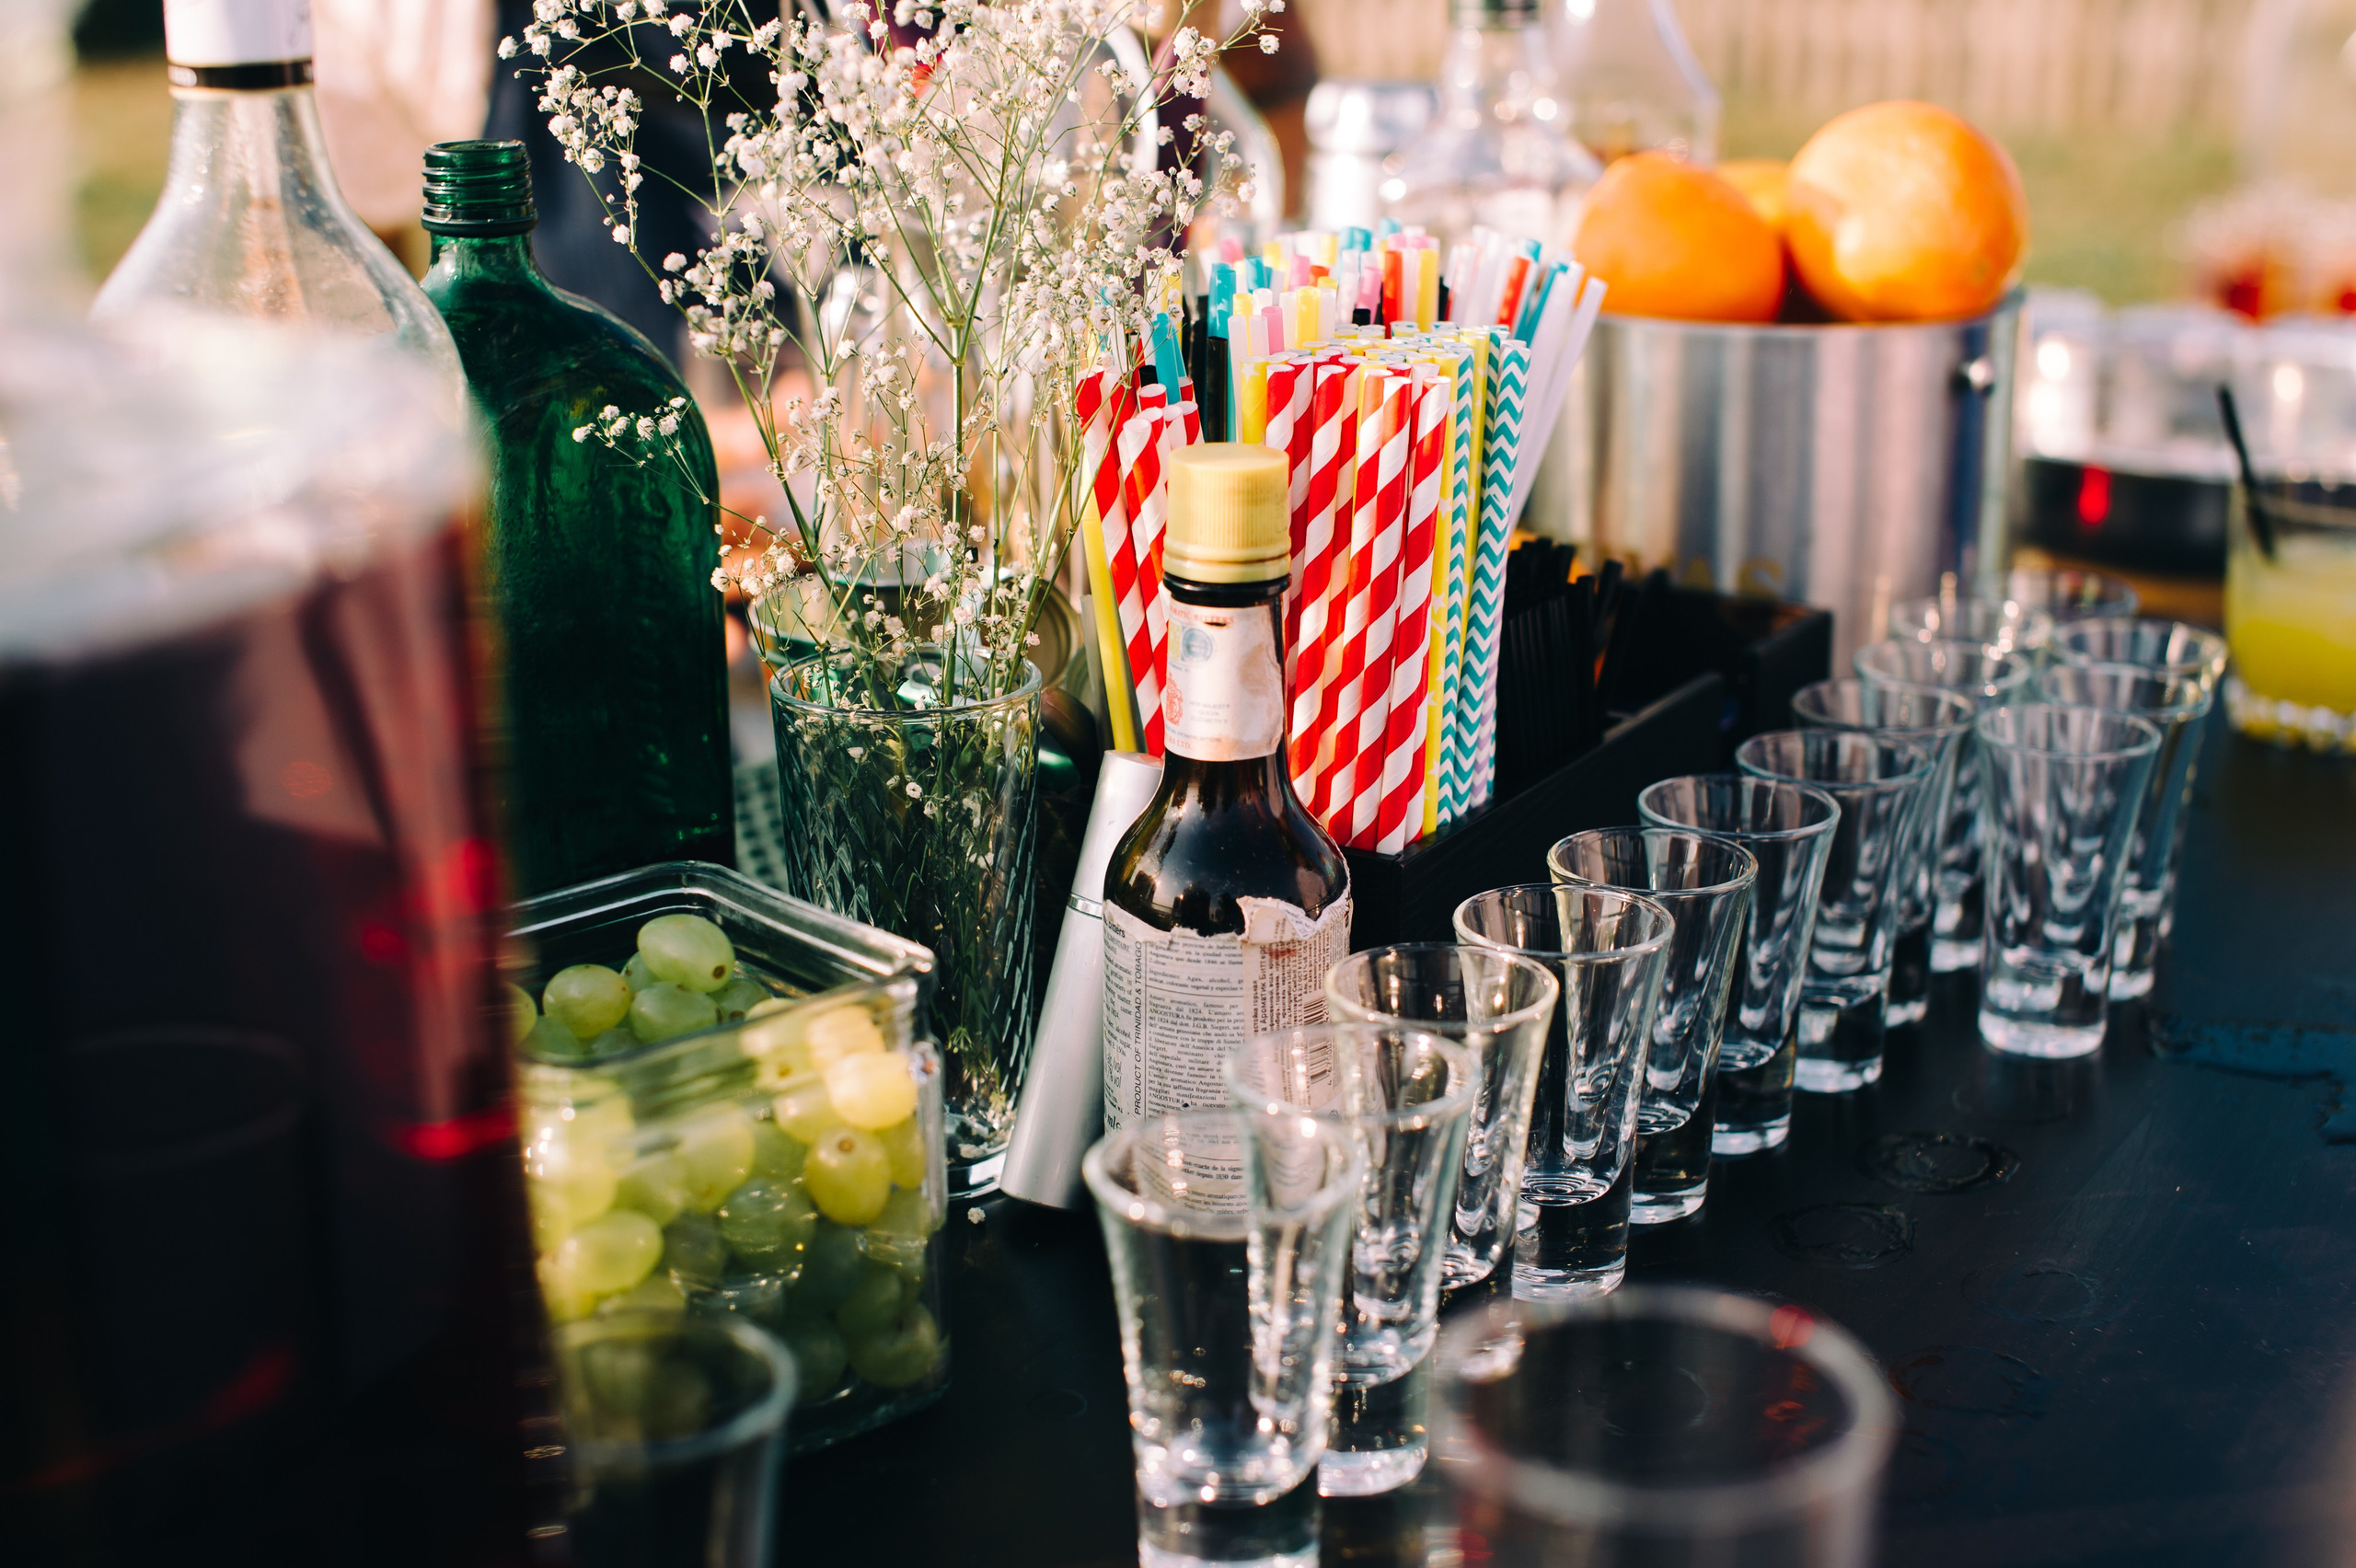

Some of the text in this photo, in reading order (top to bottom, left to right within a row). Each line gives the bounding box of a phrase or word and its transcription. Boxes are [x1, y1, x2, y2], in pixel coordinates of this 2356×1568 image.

[1149, 1000, 1172, 1010] fragranza
[1170, 998, 1198, 1007] aromatico,
[1260, 982, 1268, 1024] Ароматик
[1149, 1008, 1184, 1020] ANGOSTURA
[1134, 997, 1142, 1044] TRINIDAD
[1134, 1048, 1142, 1062] OF
[1164, 1068, 1184, 1077] divenne
[1171, 1077, 1196, 1085] aromatico
[1134, 1066, 1142, 1115] PRODUCT
[1149, 1086, 1171, 1096] maggiori
[1176, 1091, 1217, 1101] manifestazioni
[1195, 1087, 1220, 1095] fragranza
[1149, 1100, 1183, 1111] riconosciment
